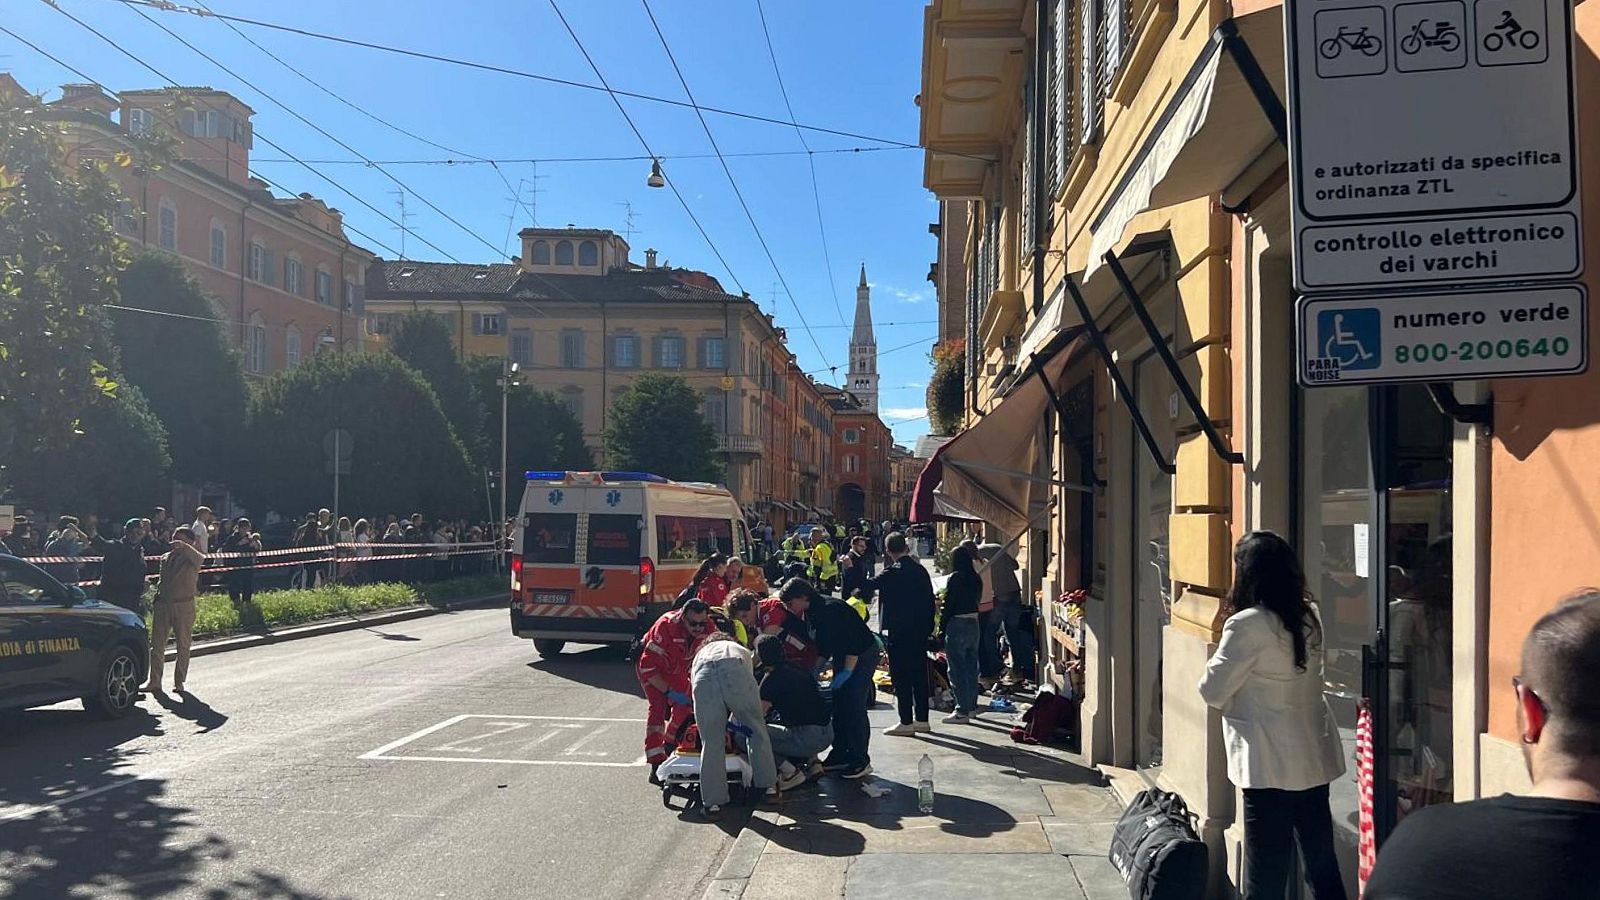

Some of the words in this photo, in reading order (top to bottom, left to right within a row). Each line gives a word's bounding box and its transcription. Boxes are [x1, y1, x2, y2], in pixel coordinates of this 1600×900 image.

[1315, 166, 1325, 178] e
[1331, 158, 1435, 177] autorizzati
[1441, 156, 1464, 171] da
[1471, 151, 1561, 171] specifica
[1315, 183, 1410, 200] ordinanza
[1417, 179, 1454, 195] ZTL
[1314, 231, 1422, 252] controllo
[1430, 223, 1564, 246] elettronico
[1380, 256, 1415, 273] dei
[1423, 250, 1497, 271] varchi
[1393, 310, 1486, 328] numero
[1500, 303, 1570, 323] verde
[1395, 336, 1569, 363] 800-200640
[1308, 359, 1340, 370] PARA
[1308, 370, 1340, 380] NOISE
[25, 640, 36, 655] di
[38, 637, 80, 653] FINANZA
